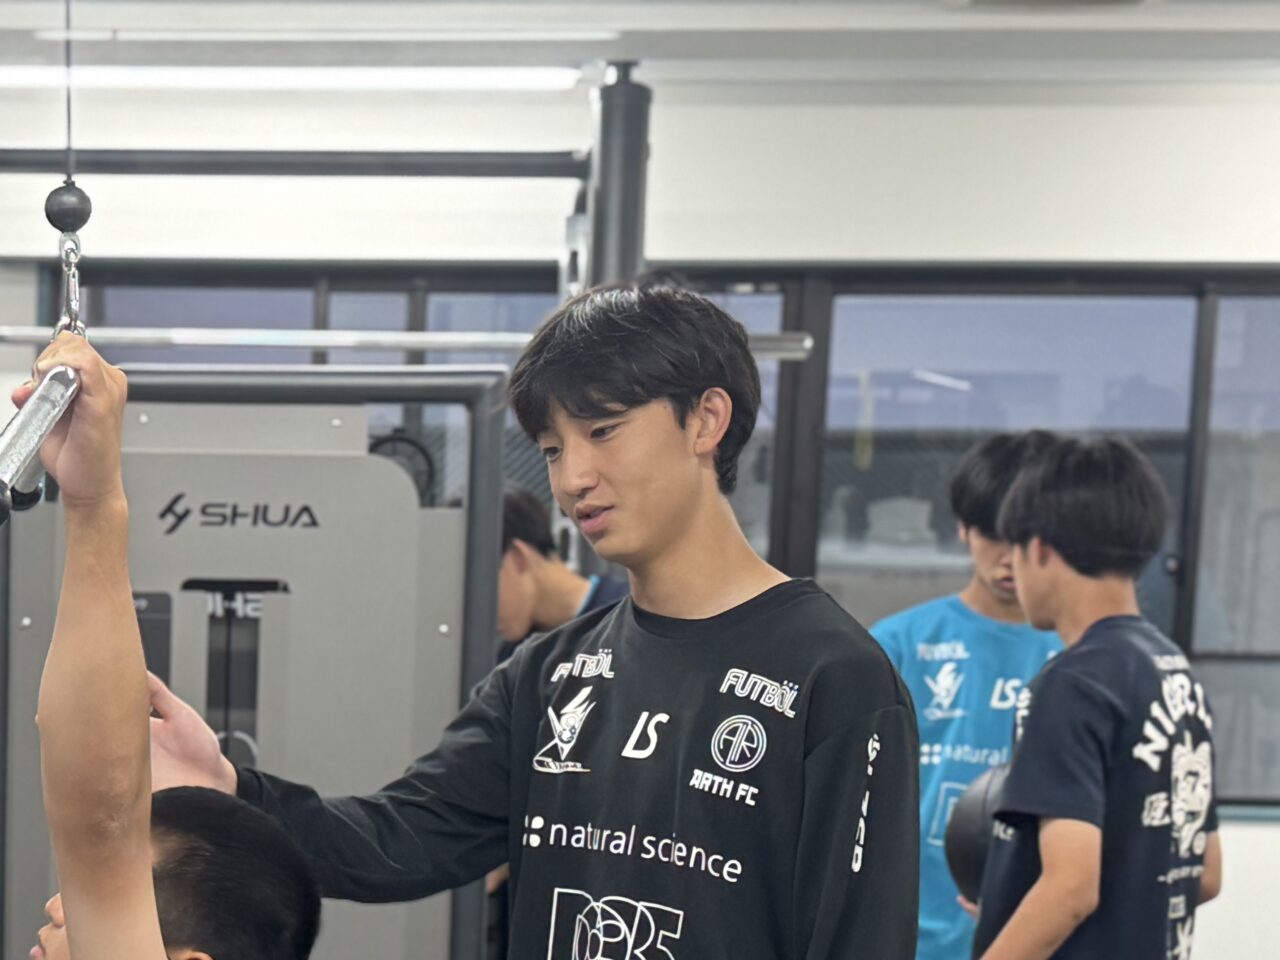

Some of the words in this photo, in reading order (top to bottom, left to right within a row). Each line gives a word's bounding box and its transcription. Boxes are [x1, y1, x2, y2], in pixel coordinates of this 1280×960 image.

[200, 503, 319, 528] SHUA
[689, 768, 735, 799] ARTH
[735, 782, 759, 806] FC
[549, 822, 636, 856] natural
[640, 832, 742, 883] science
